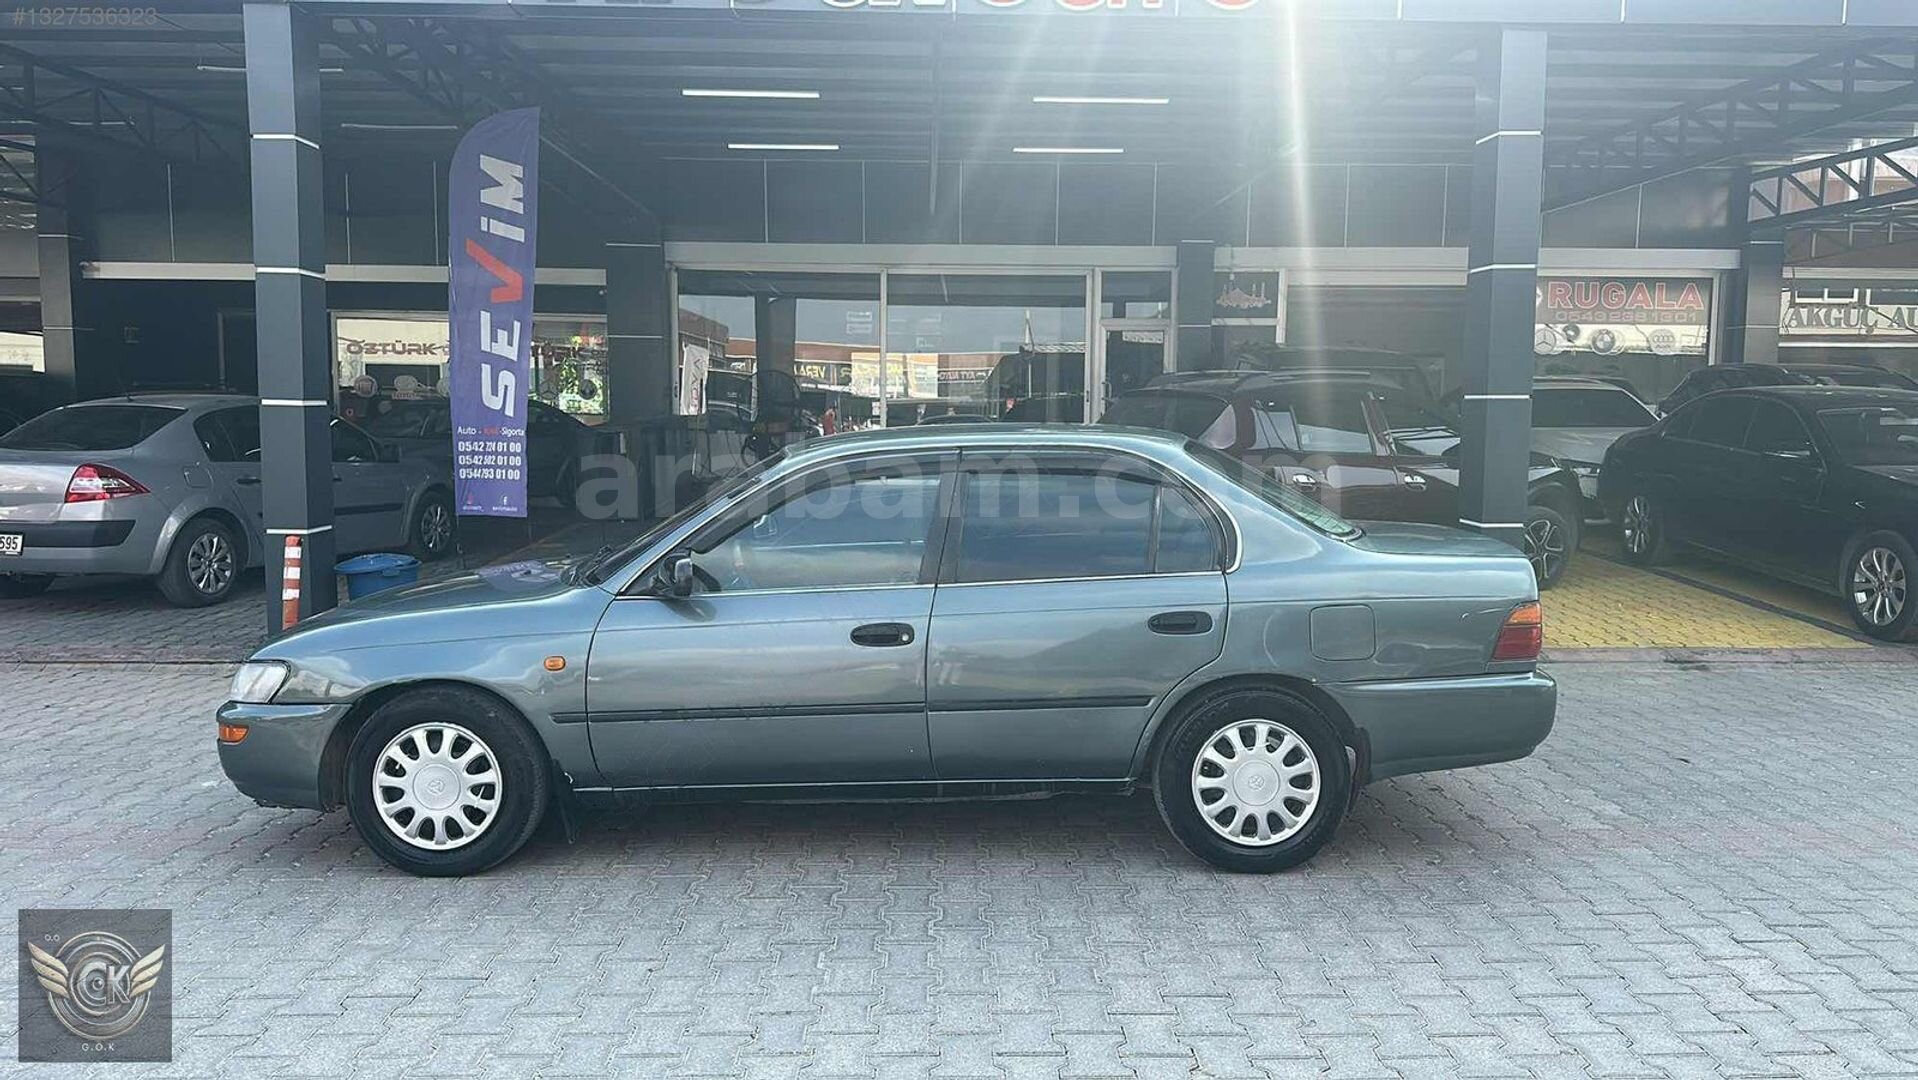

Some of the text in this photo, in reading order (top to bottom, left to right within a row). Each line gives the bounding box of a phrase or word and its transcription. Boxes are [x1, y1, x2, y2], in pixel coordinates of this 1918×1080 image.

[1547, 281, 1704, 310] RUGALA
[457, 426, 476, 434] Auto
[497, 442, 507, 452] 01
[509, 442, 521, 453] 00
[497, 456, 507, 466] 01
[509, 456, 521, 467] 00
[496, 469, 506, 480] 01
[507, 469, 520, 480] 00
